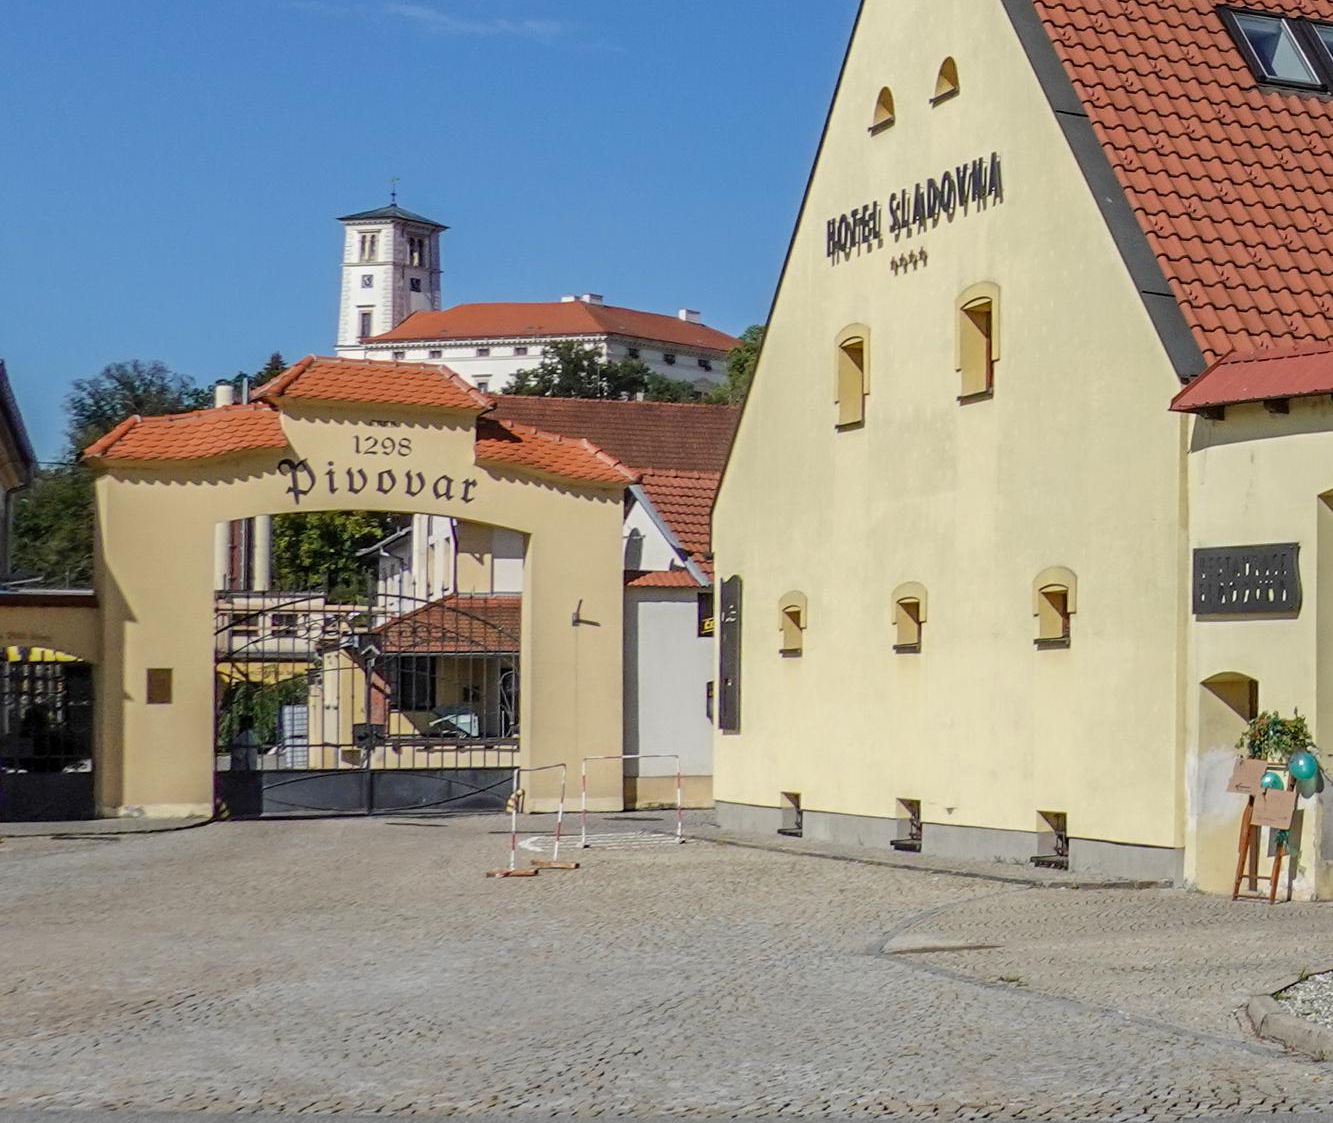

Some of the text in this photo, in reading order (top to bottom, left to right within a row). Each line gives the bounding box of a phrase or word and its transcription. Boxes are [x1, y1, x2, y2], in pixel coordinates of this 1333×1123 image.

[826, 151, 1001, 258] HOTEL SLADOVNA
[353, 435, 413, 457] 1298
[277, 457, 478, 505] Pivovar
